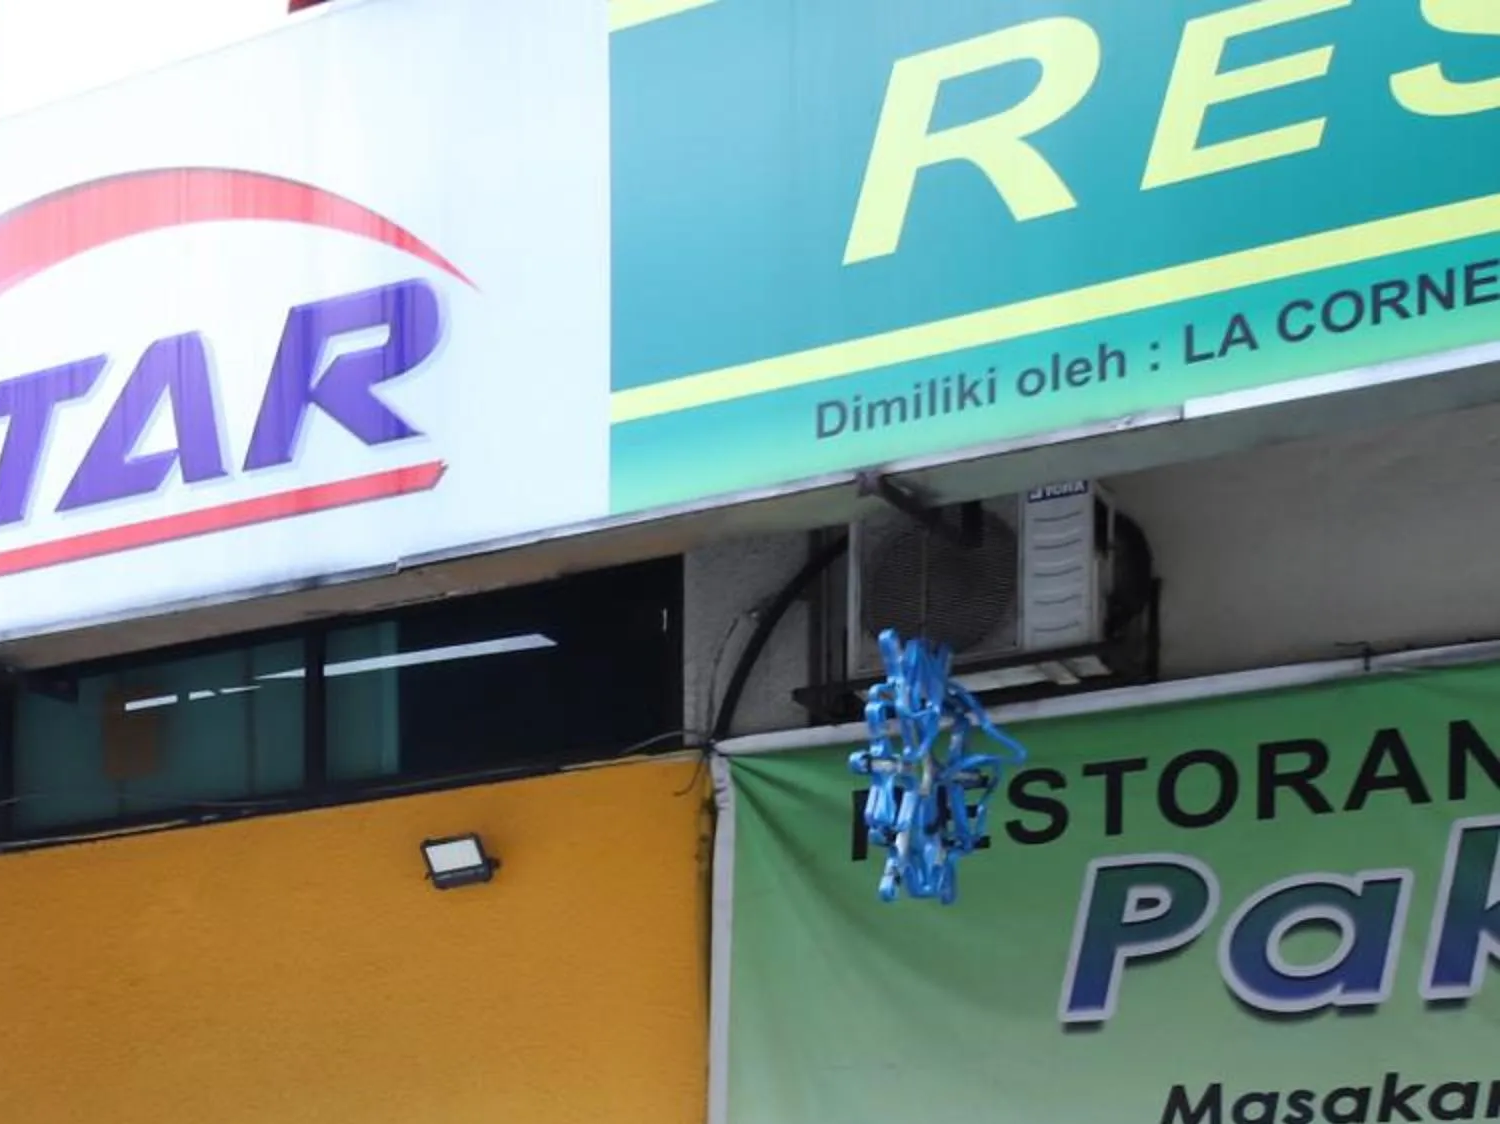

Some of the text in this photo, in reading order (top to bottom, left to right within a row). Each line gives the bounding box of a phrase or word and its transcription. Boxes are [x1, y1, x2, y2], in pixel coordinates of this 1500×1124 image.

[816, 368, 997, 440] Dimiliki
[1016, 343, 1128, 399] oleh
[1184, 313, 1259, 365] LA
[1277, 258, 1500, 343] CORNE
